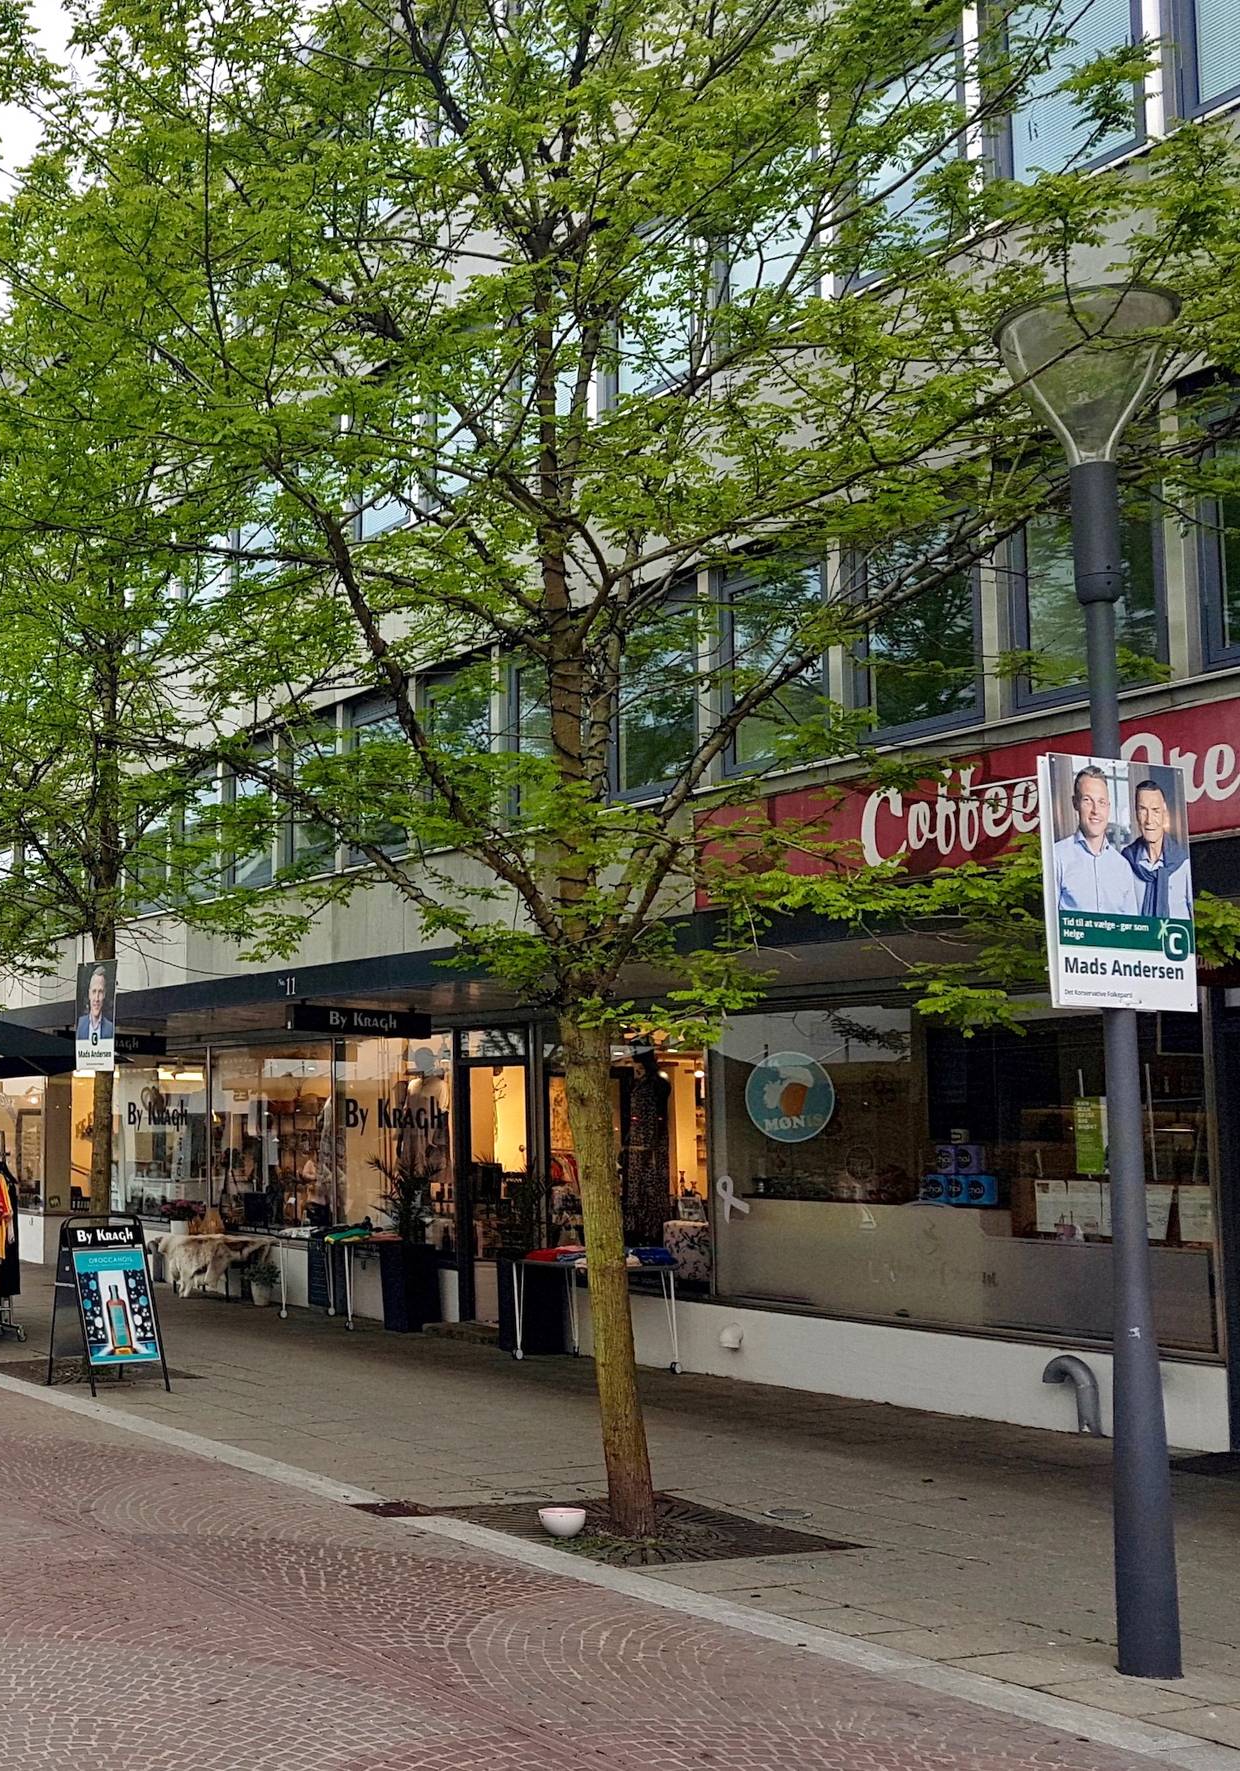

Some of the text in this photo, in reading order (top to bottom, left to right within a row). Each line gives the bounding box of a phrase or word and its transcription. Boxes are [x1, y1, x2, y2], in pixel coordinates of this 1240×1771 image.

[861, 765, 1040, 867] Coffee
[1062, 917, 1075, 927] Tid
[1076, 918, 1084, 927] til
[1085, 920, 1094, 928] at
[1094, 920, 1116, 932] vælge
[1120, 923, 1133, 932] gør
[1133, 924, 1150, 932] som
[1063, 929, 1085, 940] Helge
[1064, 956, 1107, 975] Mads
[1111, 959, 1184, 980] Andersen
[285, 976, 297, 996] 11
[329, 1010, 398, 1032] By Kragh
[78, 1049, 112, 1058] Mads Andersen
[127, 1099, 188, 1132] By Kragh
[345, 1096, 450, 1140] By Kragh
[76, 1227, 134, 1245] By Kragh
